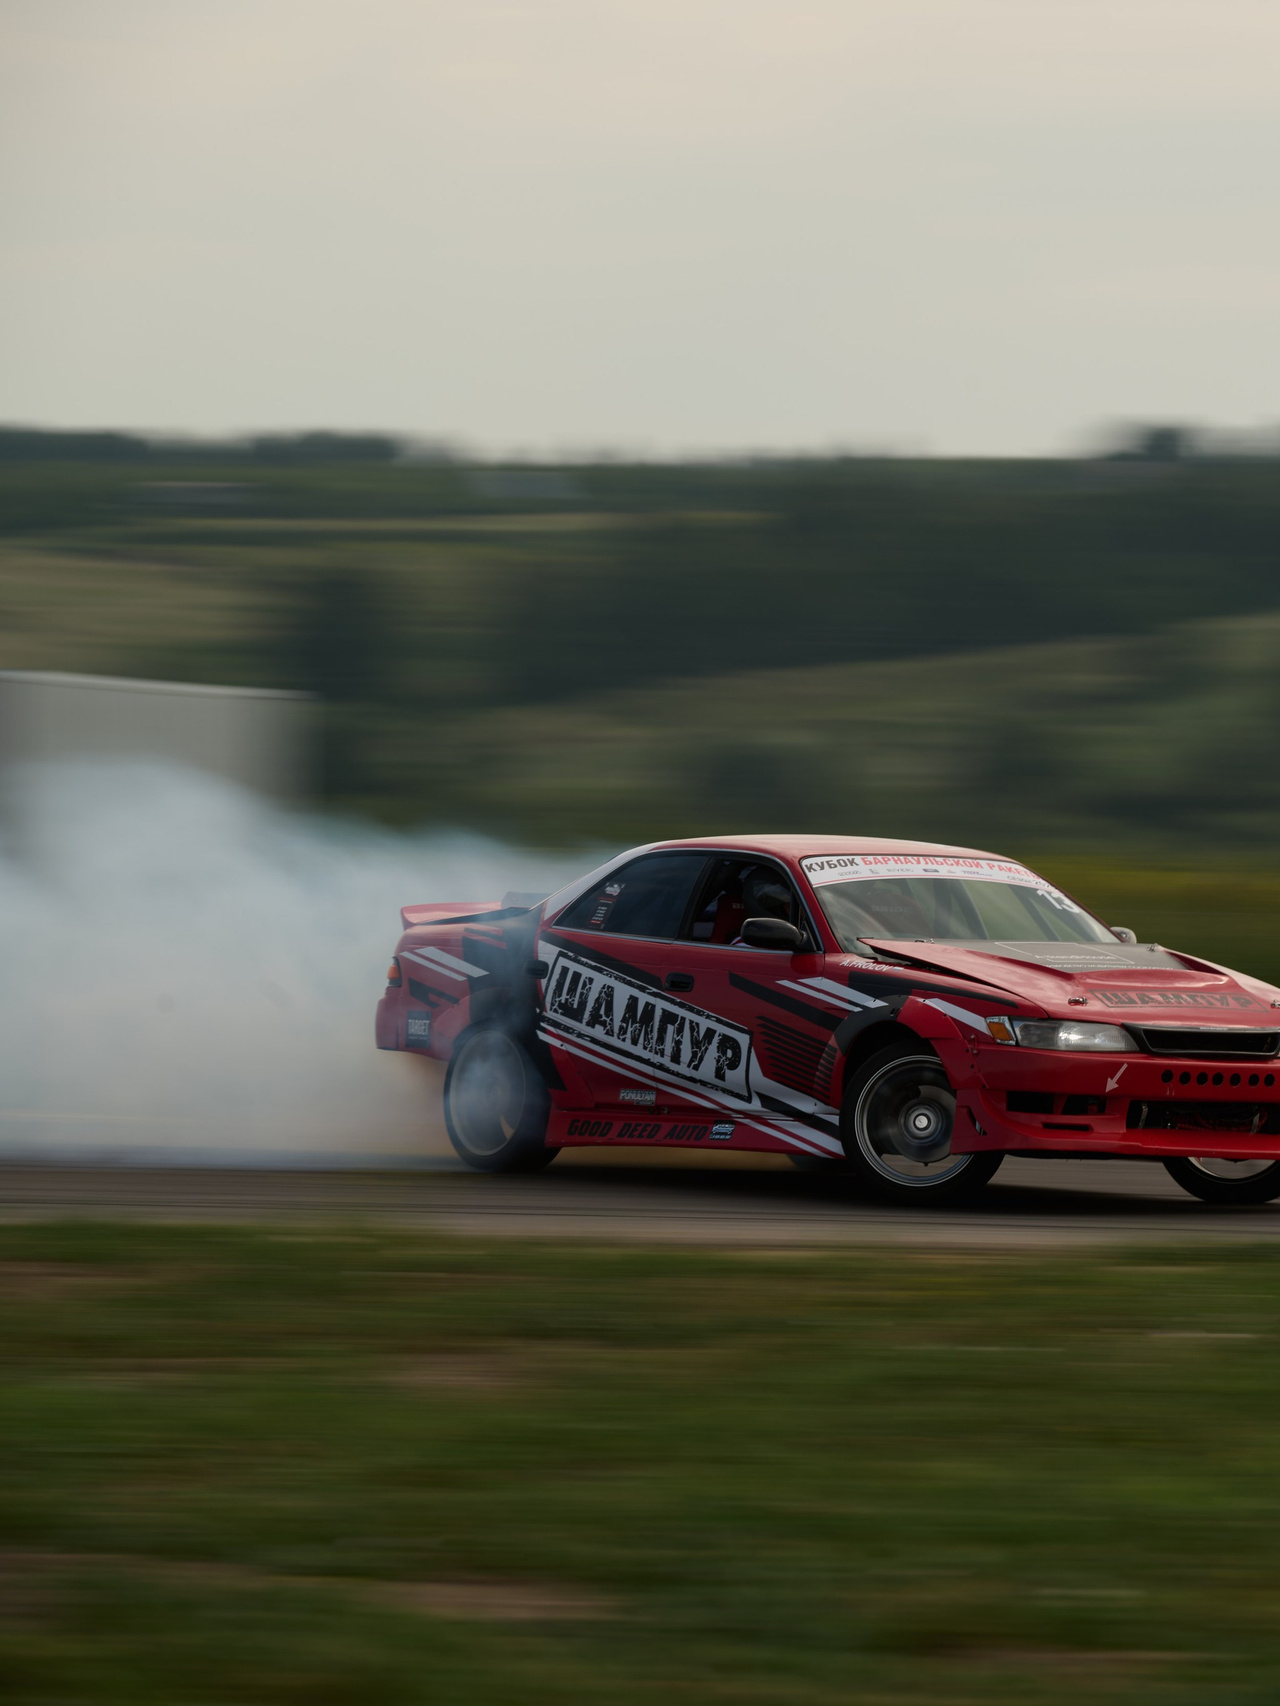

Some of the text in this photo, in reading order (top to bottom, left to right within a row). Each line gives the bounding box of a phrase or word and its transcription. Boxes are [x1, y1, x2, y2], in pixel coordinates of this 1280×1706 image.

[804, 857, 859, 873] КУБОК
[860, 856, 983, 869] БАРНАУЛЬСКОЙ
[839, 959, 895, 972] A.FROLOV
[1100, 991, 1254, 1009] ШАМПУР
[408, 1019, 430, 1035] TARGET
[549, 965, 742, 1083] ШАМПУР
